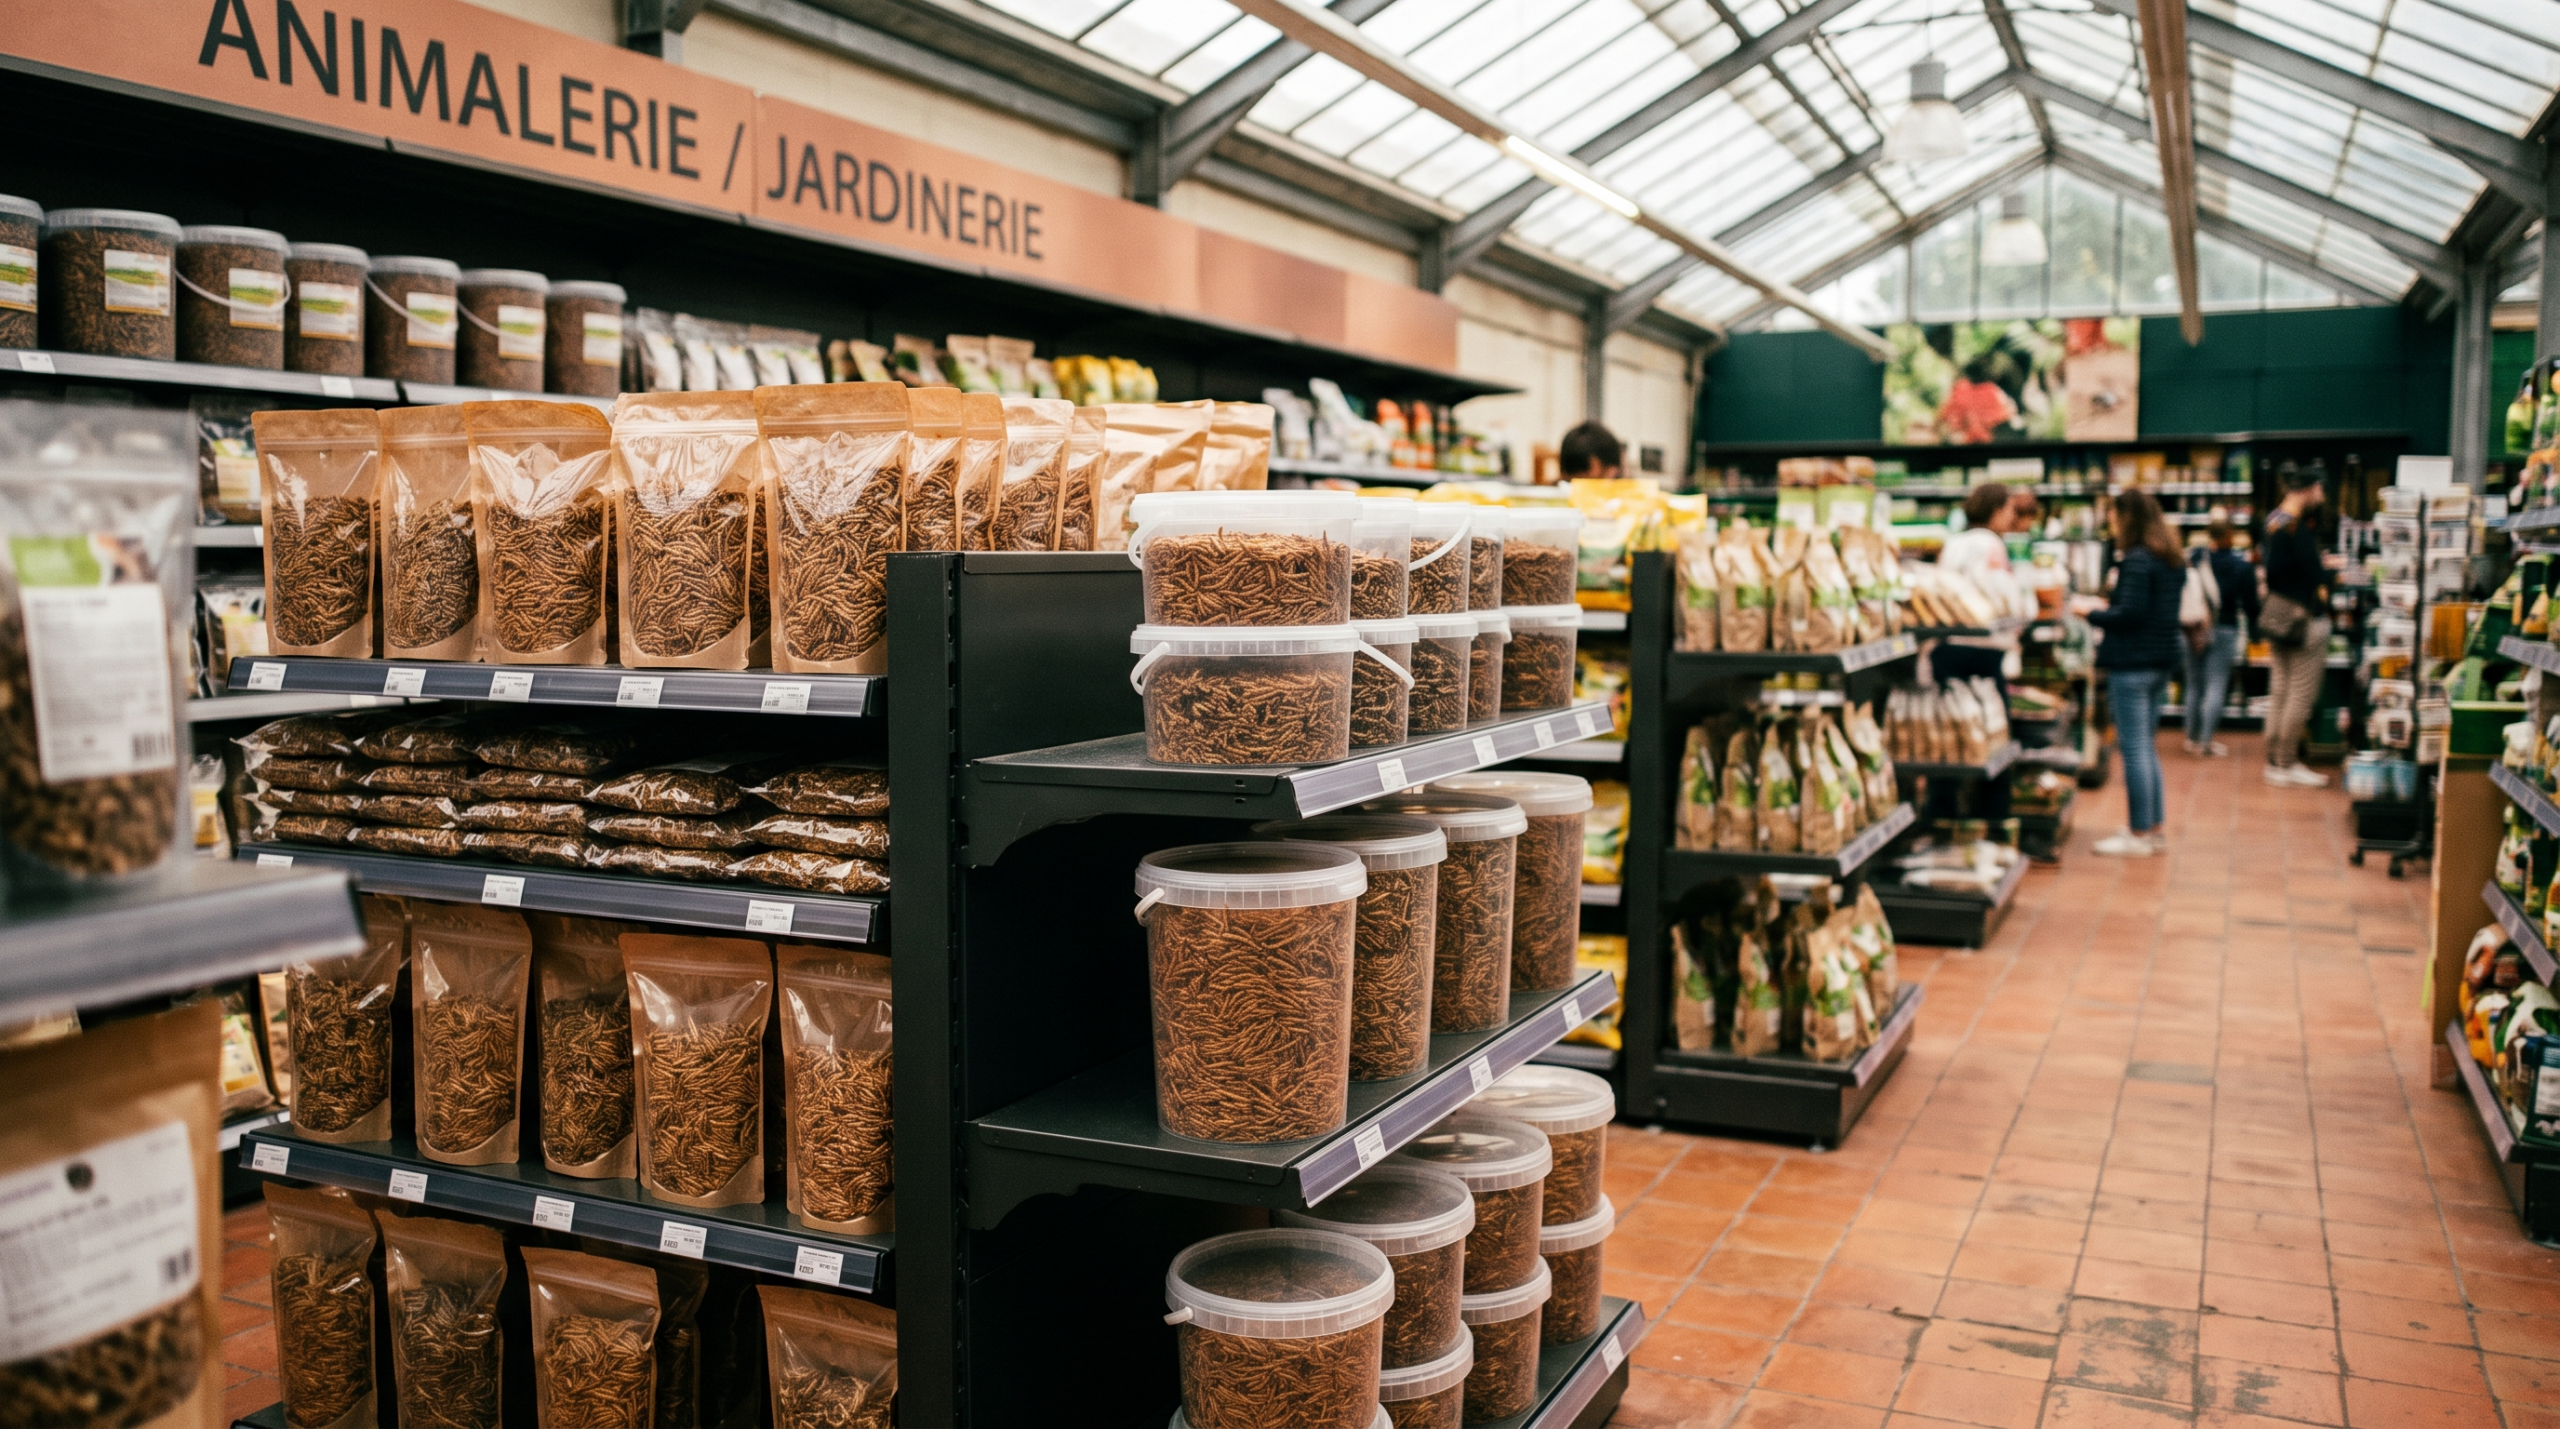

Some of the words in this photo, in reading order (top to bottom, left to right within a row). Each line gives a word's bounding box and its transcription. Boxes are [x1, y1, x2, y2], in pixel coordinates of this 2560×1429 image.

[198, 0, 700, 180] ANIMALERIE
[722, 122, 745, 192] /
[767, 135, 1044, 261] JARDINERIE
